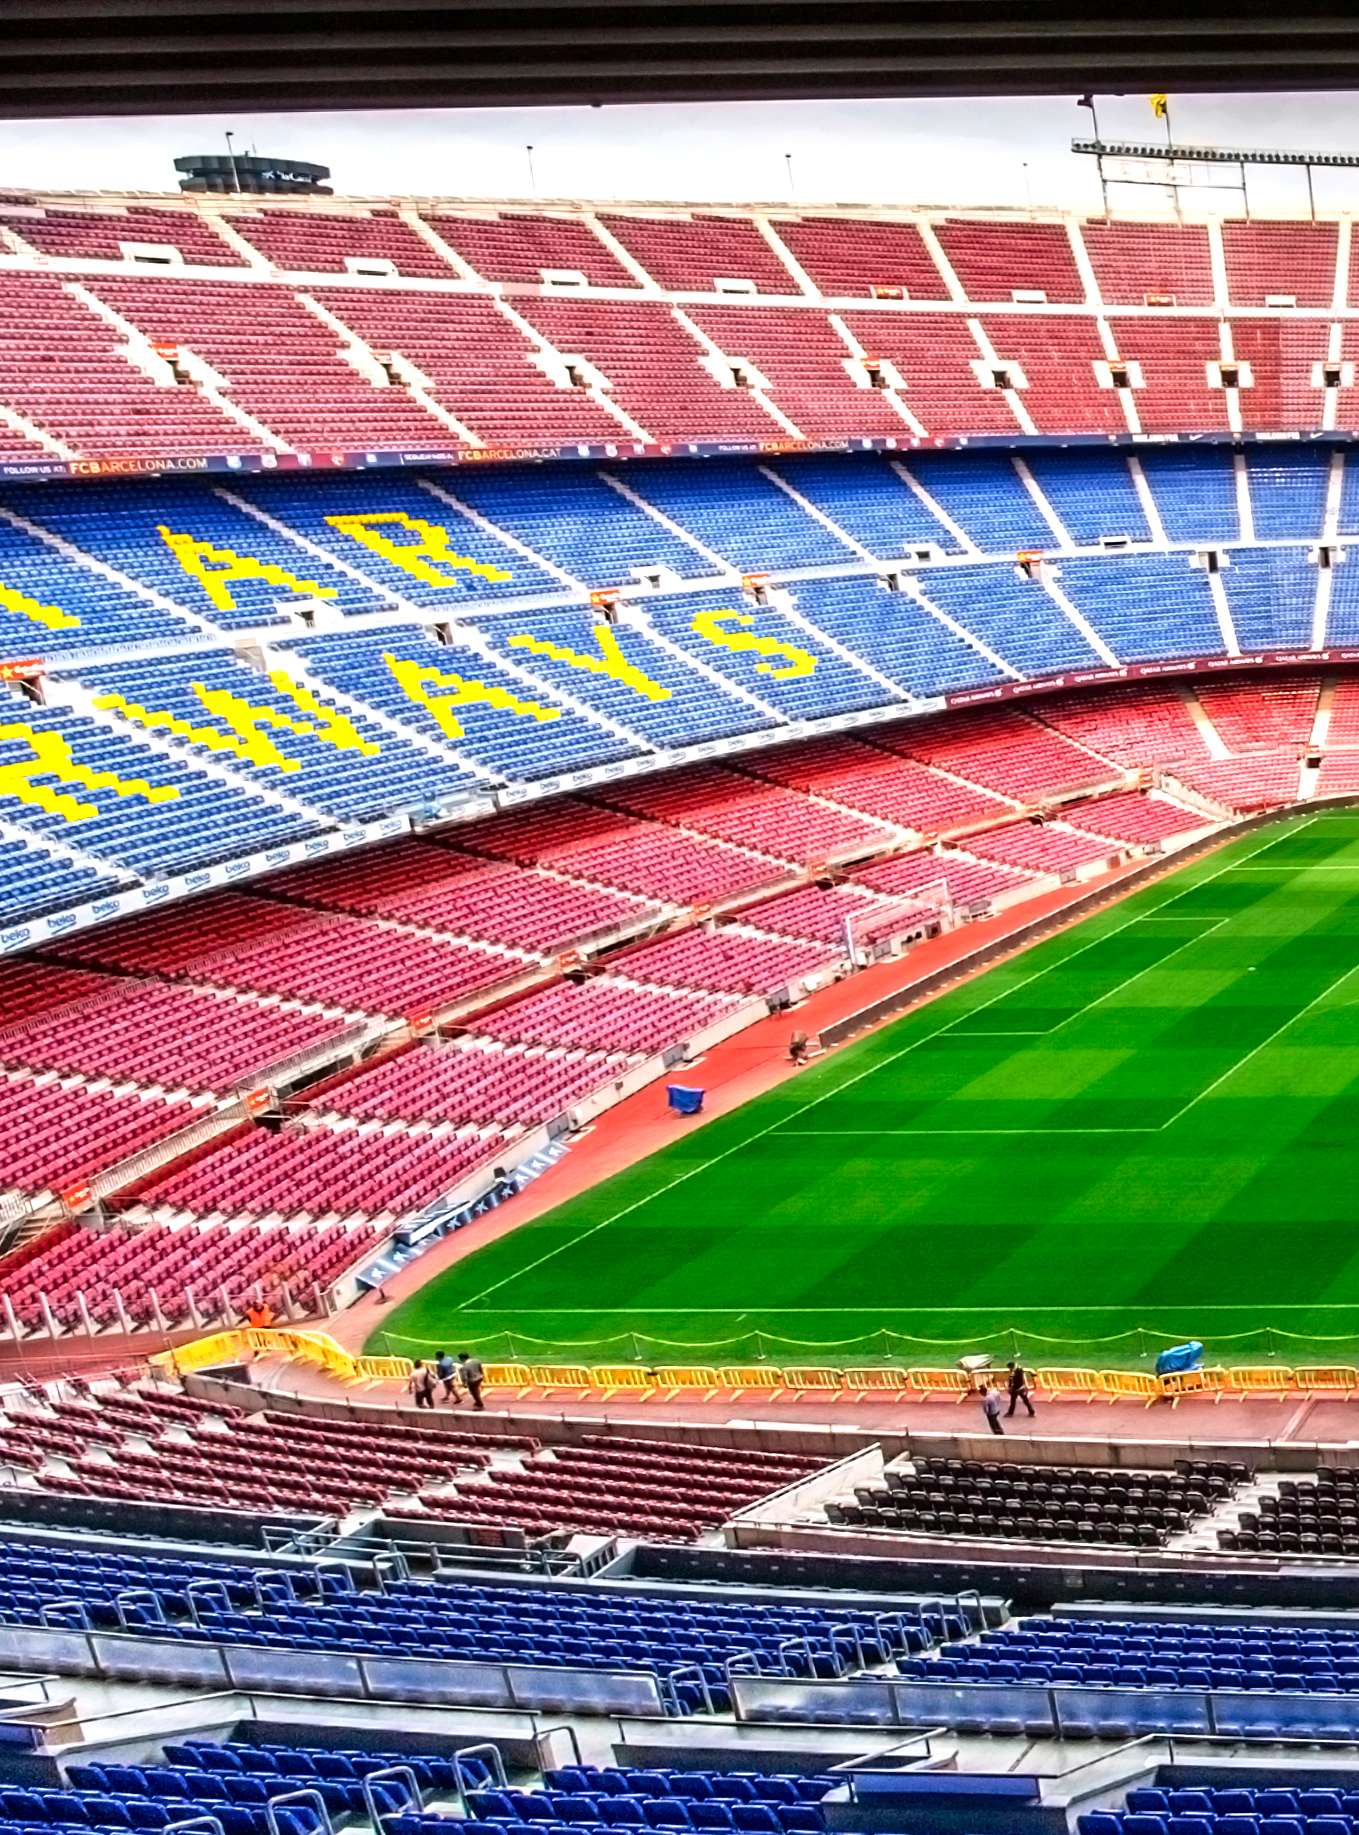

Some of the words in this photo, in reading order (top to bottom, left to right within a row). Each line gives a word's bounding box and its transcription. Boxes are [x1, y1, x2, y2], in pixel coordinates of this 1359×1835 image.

[457, 447, 562, 461] FCBARCELONA.CAT
[69, 457, 208, 475] FCBARCELONA.COM
[185, 872, 210, 886] beko
[143, 884, 169, 898] beko
[92, 900, 120, 914] beko
[47, 913, 76, 928] beko
[1, 928, 30, 944] beko
